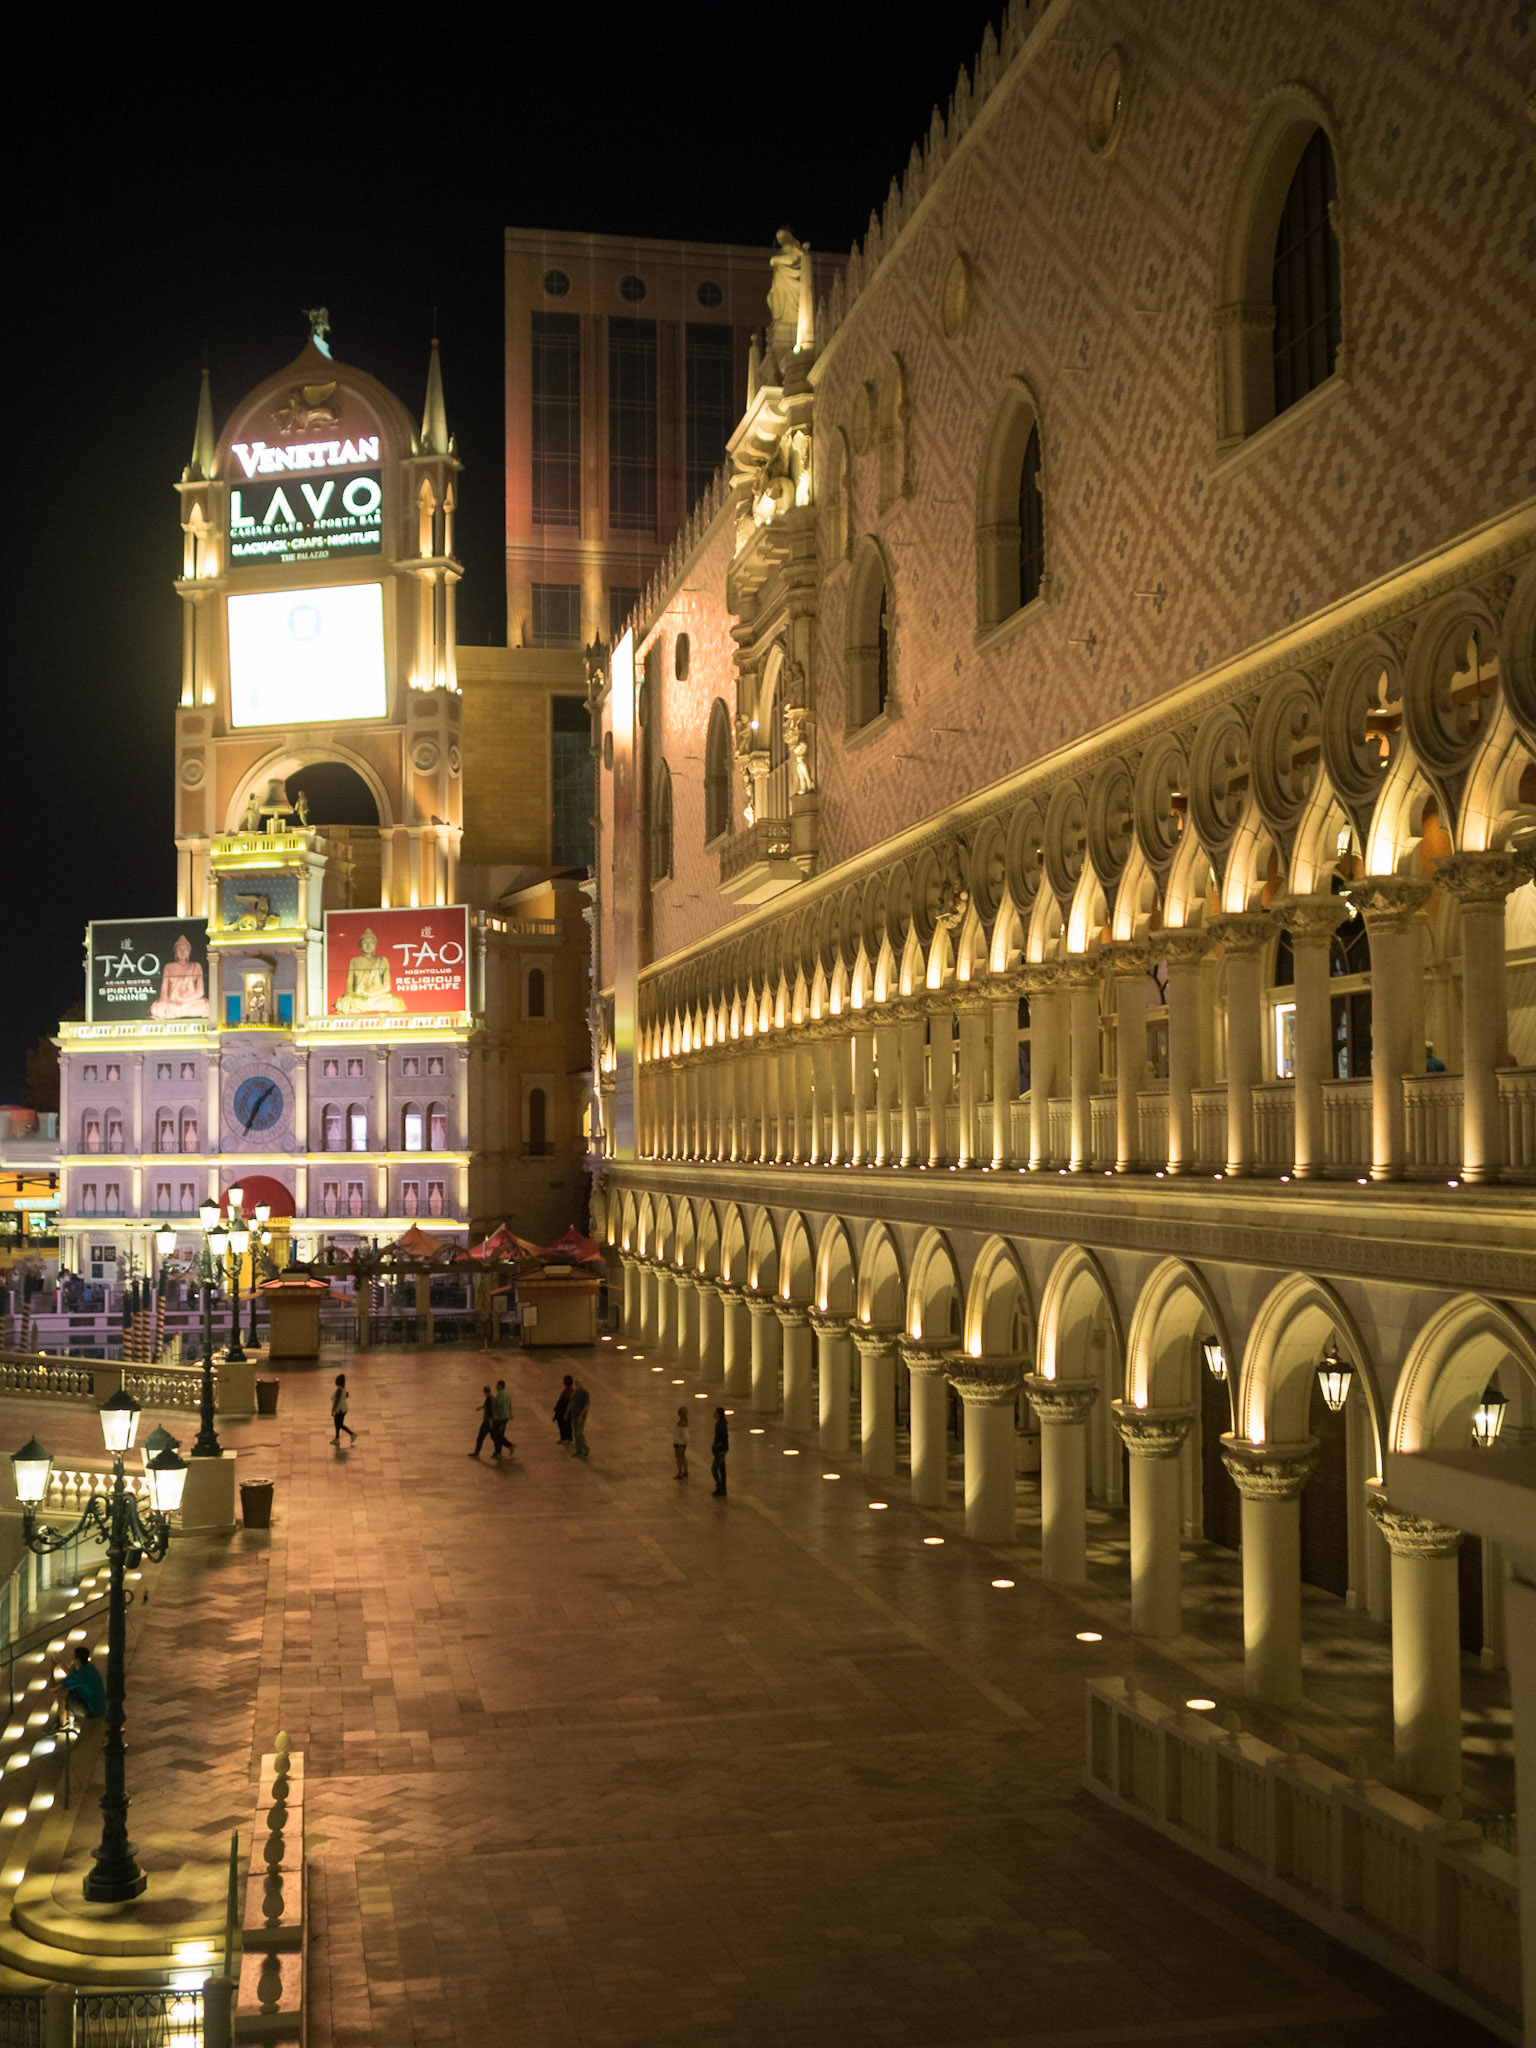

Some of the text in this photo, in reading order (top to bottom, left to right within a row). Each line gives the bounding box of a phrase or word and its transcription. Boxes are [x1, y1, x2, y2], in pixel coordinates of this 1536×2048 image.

[231, 436, 379, 479] VENETIAN
[230, 477, 382, 528] LAVO
[230, 514, 382, 538] CASINO CLUB SPORTS BAR
[232, 530, 380, 557] BLACKJACK CRAPS NIGHTLIFE
[281, 550, 329, 563] THE PALAZZO
[94, 952, 160, 978] TAO
[392, 941, 464, 968] TAO
[98, 986, 157, 996] SPIRITUAL
[395, 975, 462, 985] RELIGIOUS
[396, 982, 460, 992] NIGHTLIFE
[106, 993, 148, 1002] DINING
